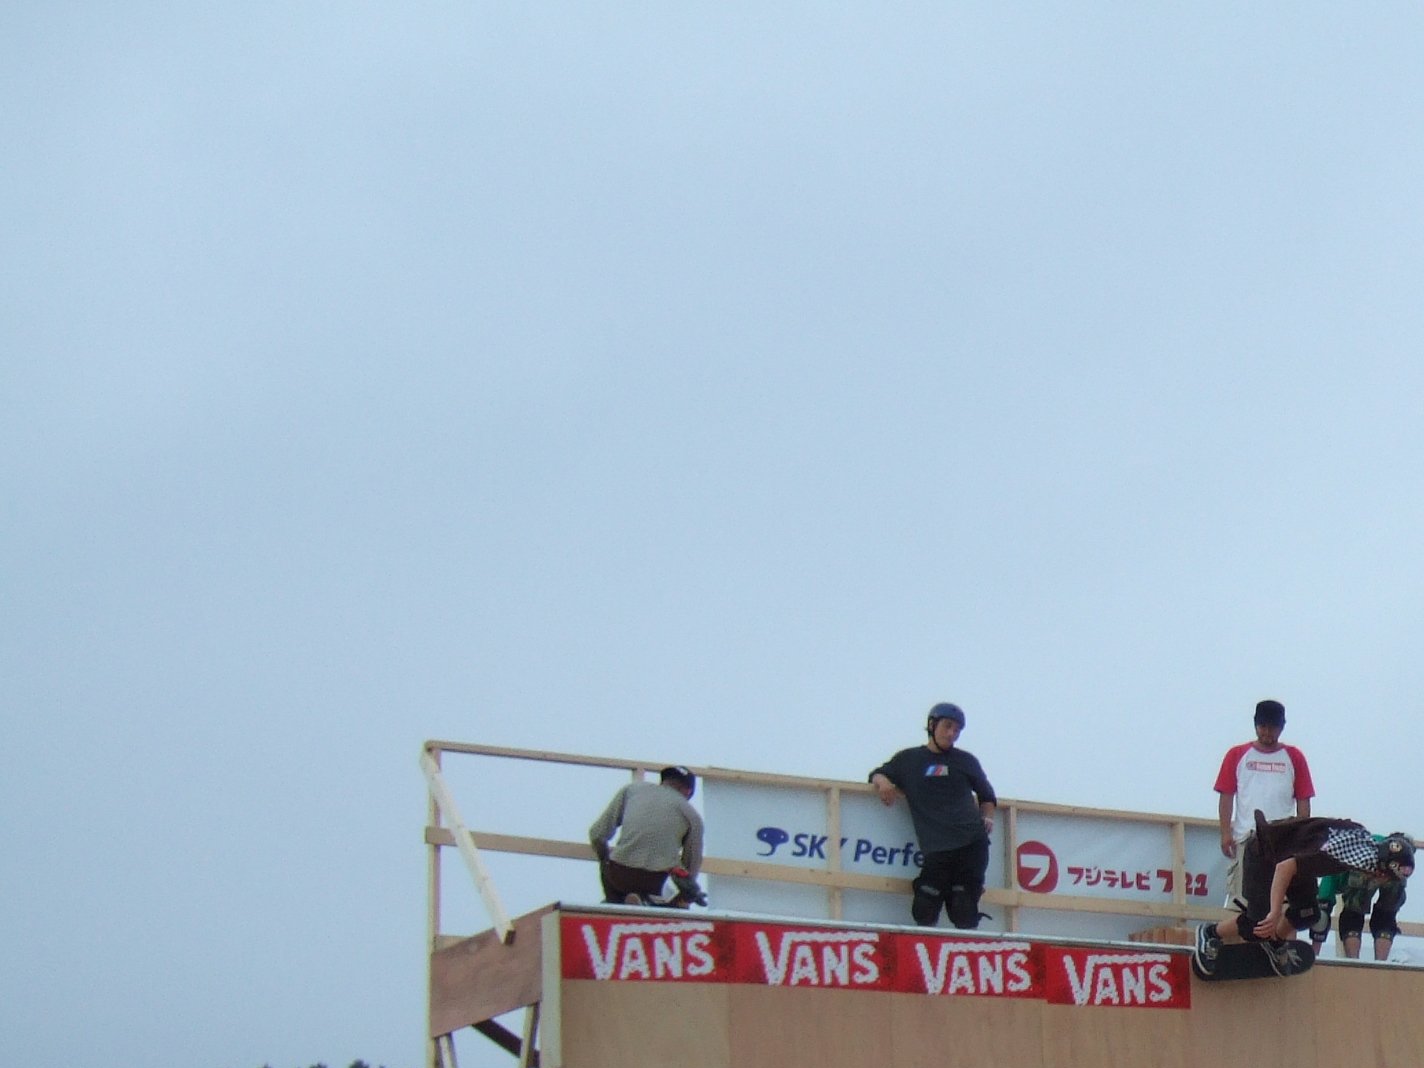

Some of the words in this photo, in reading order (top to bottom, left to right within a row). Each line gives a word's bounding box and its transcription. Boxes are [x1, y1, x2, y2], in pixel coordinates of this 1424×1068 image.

[792, 833, 847, 859] SK
[582, 922, 715, 980] VANS
[755, 931, 880, 986] VANS
[915, 942, 1032, 995] VANS
[1063, 953, 1172, 1006] VANS
